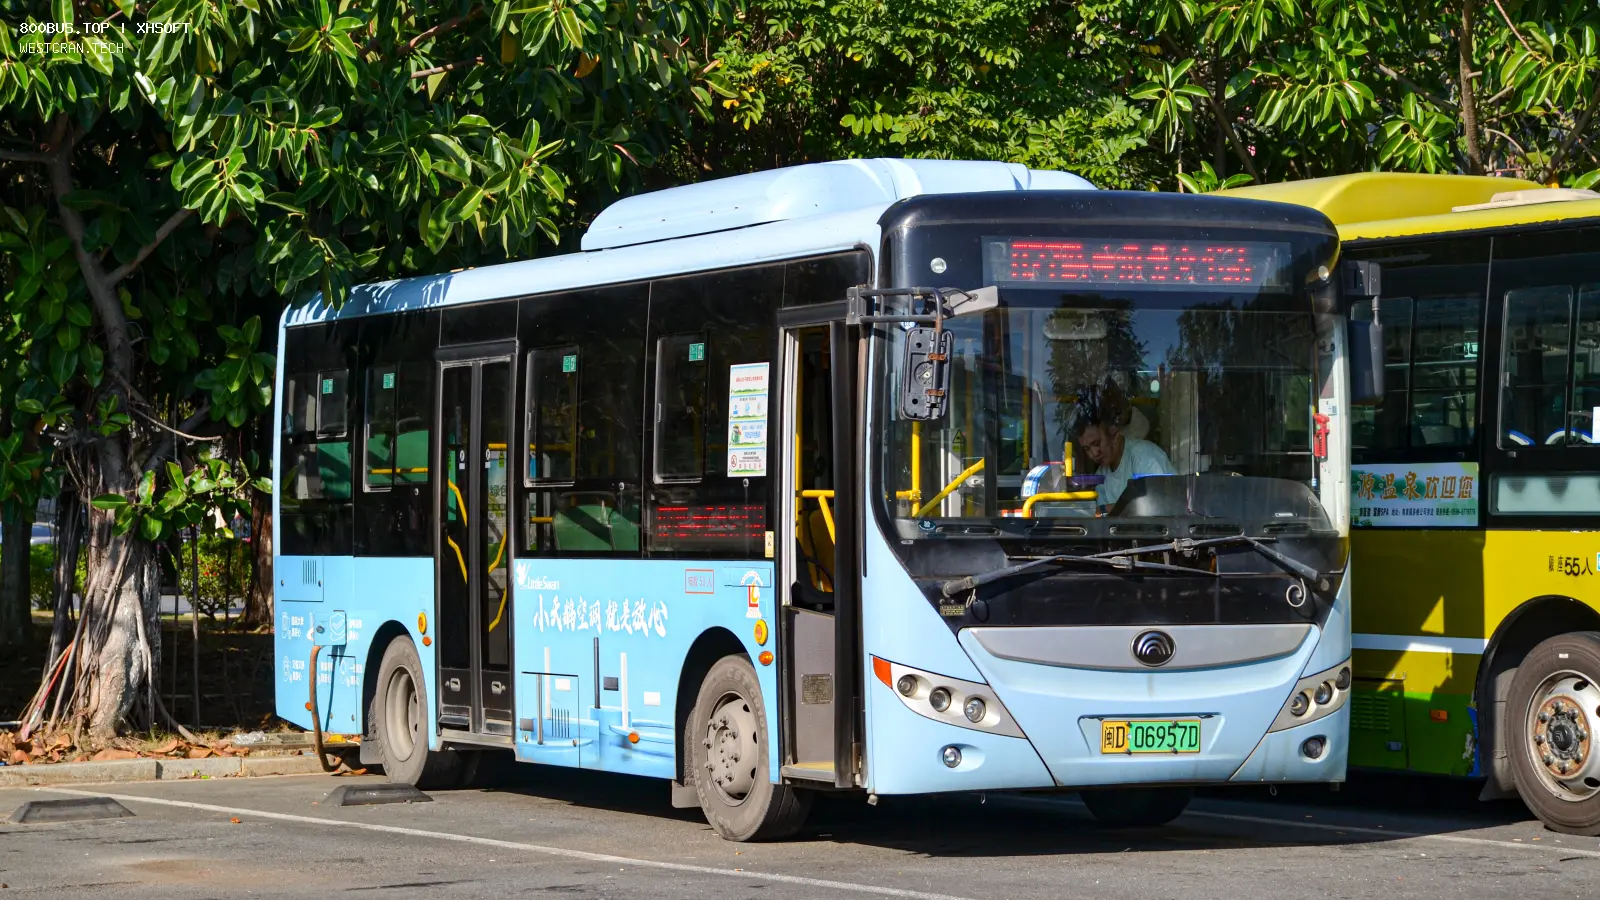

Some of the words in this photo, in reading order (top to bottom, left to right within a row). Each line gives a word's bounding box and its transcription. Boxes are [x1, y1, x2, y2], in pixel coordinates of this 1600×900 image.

[605, 597, 669, 638] 就是放心
[1103, 726, 1126, 749] 闽D
[1134, 725, 1198, 748] 06957D
